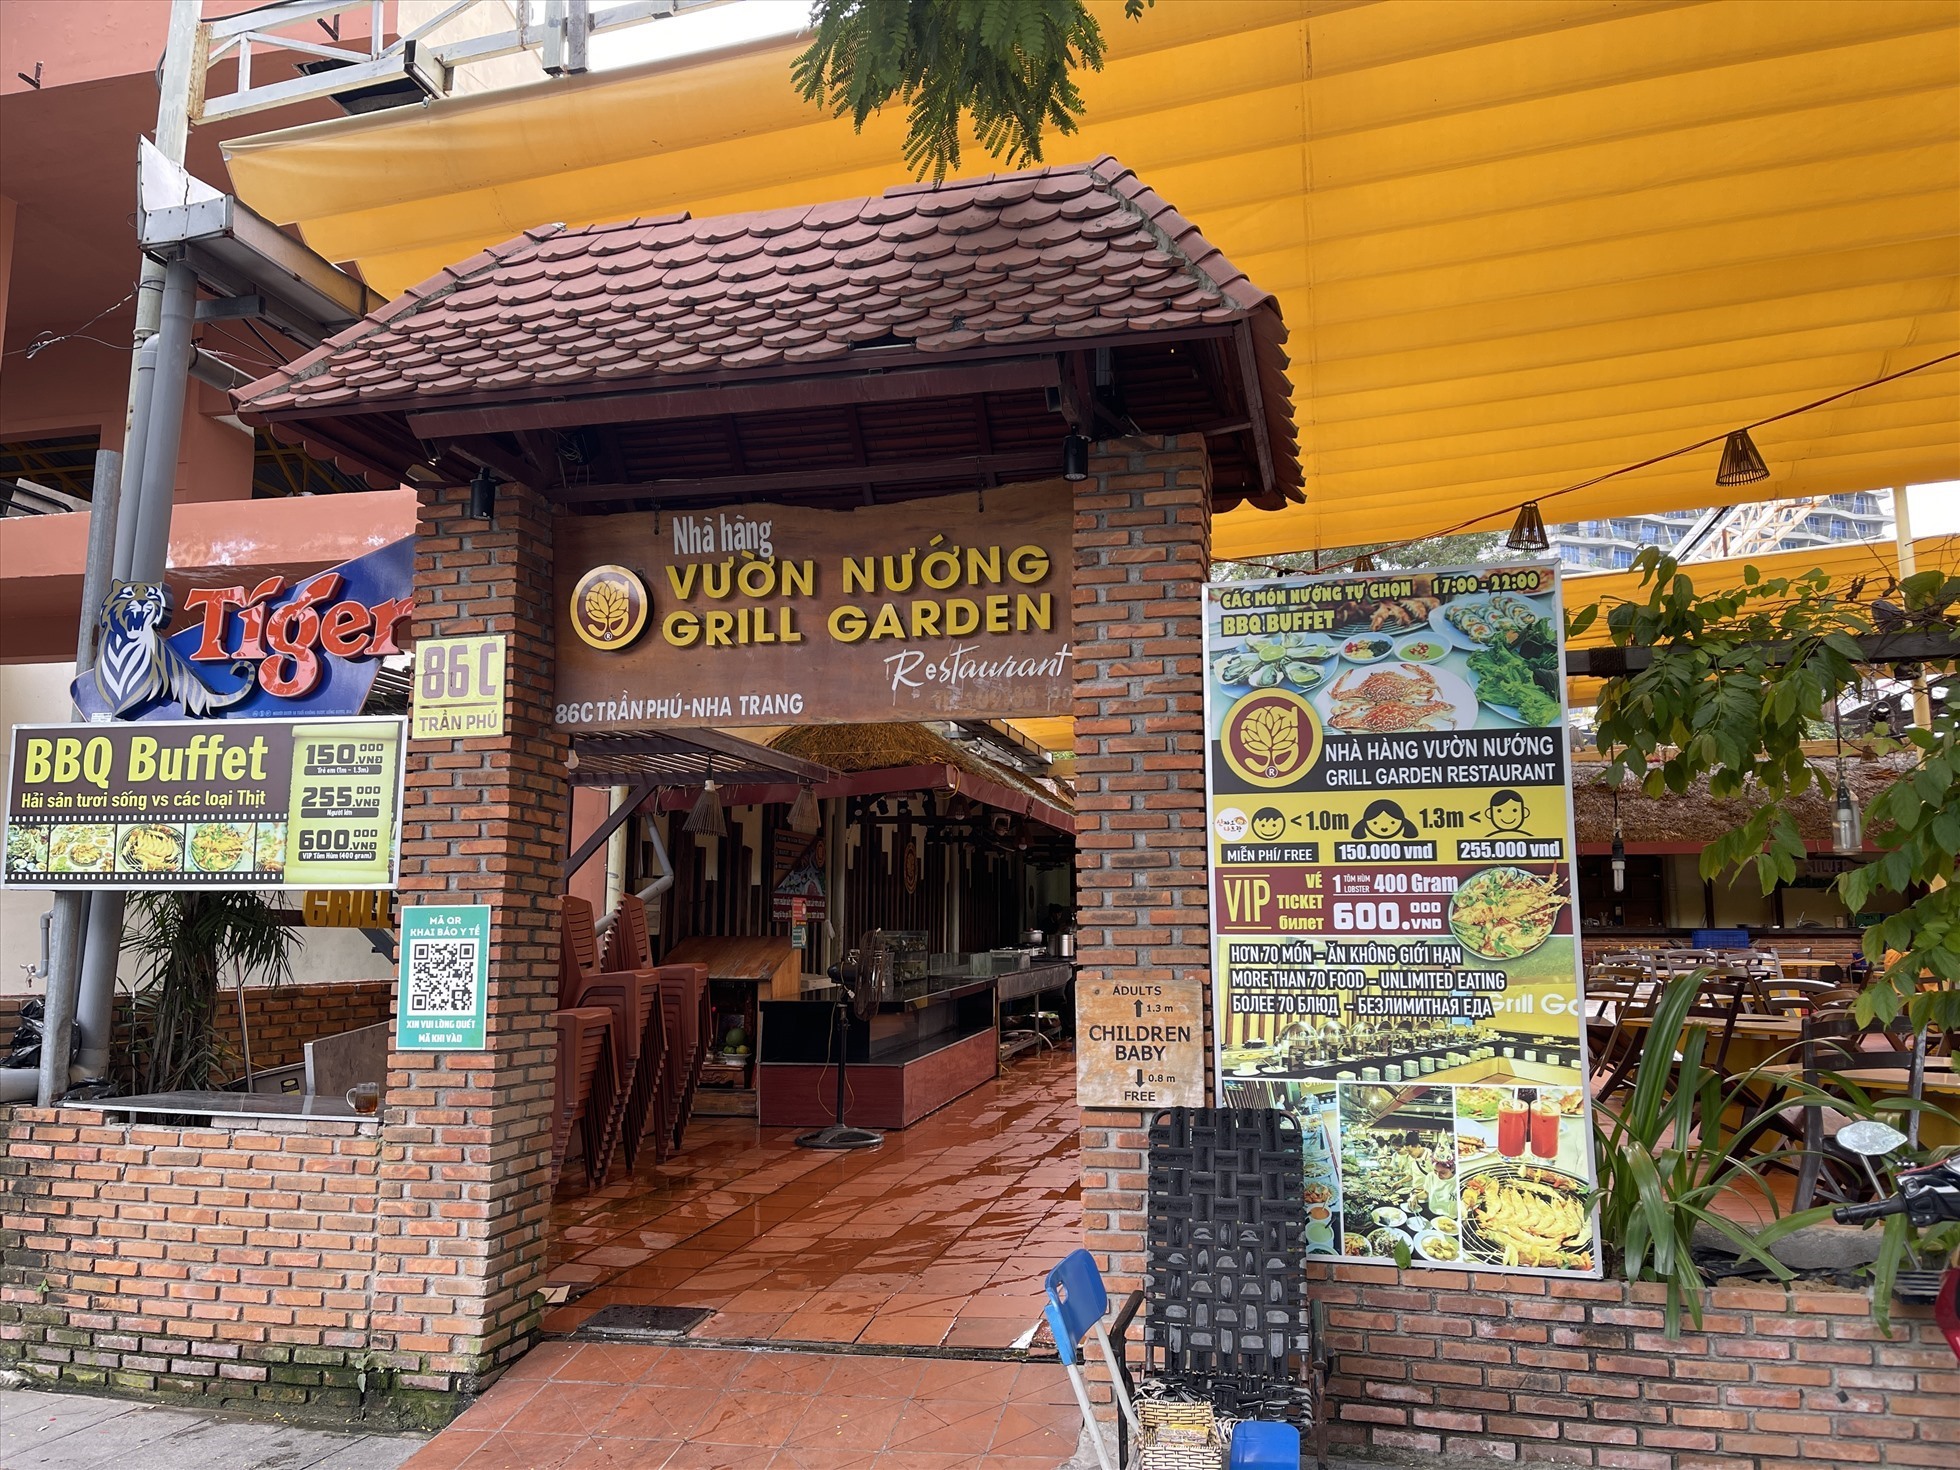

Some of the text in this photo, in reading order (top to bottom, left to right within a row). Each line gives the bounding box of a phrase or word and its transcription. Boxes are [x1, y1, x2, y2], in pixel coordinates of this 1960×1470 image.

[673, 514, 773, 557] Nhà hàng
[665, 533, 1050, 600] VƯỜN NƯỚNG
[1222, 590, 1251, 608] CÁC
[1255, 589, 1286, 606] MÓN
[1290, 584, 1342, 604] NƯỚNG
[1345, 582, 1366, 603] TỰ
[1369, 581, 1411, 601] CHỌN
[662, 592, 1051, 646] GRILL GARDEN
[1223, 610, 1335, 636] BBQ BUFFET
[184, 572, 415, 698] Tiger
[883, 643, 1072, 691] Restaurant
[555, 702, 594, 724] 86C
[596, 690, 643, 721] TRẦN
[740, 693, 804, 716] TRANG
[419, 709, 498, 731] TRẦN PHÚ
[1325, 732, 1554, 762] NHÀ HÀNG VƯỜN NƯỚNG
[24, 734, 269, 789] BBQ Buffet
[1326, 763, 1556, 786] GRILL GARDEN RESTAURANT
[21, 788, 266, 812] Hải sản tươi sống vs các loại Thịt
[1306, 810, 1349, 831] 1.0m
[1419, 807, 1464, 829] 1.3m
[1227, 845, 1255, 862] MIỄN
[1284, 849, 1313, 861] FREE
[1338, 842, 1433, 861] 150.000 vnd
[1460, 840, 1560, 859] 255.000 vnd
[1305, 871, 1323, 889] VÉ
[1332, 873, 1459, 893] 1 TÔM HÙM 400 Gram
[1343, 885, 1371, 893] LOBSTER
[303, 890, 392, 928] GRILL
[1223, 879, 1271, 923] VIP
[1276, 894, 1324, 910] TICKET
[429, 914, 462, 925] MÃ QR
[1279, 915, 1325, 930] билет
[410, 923, 481, 937] KHAI BÁO Y TẾ
[1231, 945, 1259, 963] HƠN
[1262, 945, 1279, 963] 70
[1282, 942, 1312, 963] MÓN
[1327, 942, 1346, 963] ĂN
[1349, 943, 1396, 964] KHÔNG
[1400, 943, 1429, 964] GIỚI
[1433, 946, 1461, 967] HẠN
[1231, 970, 1269, 987] MORE
[1271, 970, 1306, 988] THAN
[1309, 971, 1326, 988] 70
[1329, 971, 1365, 989] FOOD
[1381, 972, 1453, 989] UNLIMITED
[1458, 972, 1505, 990] EATING
[1112, 985, 1162, 996] ADULTS
[1146, 1004, 1174, 1013] 1.3 m
[1232, 995, 1275, 1012] БОЛЕЕ
[1277, 996, 1294, 1013] 70
[1297, 996, 1339, 1016] БЛЮД
[1358, 997, 1459, 1015] БЕЗЛИМИТНАЯ
[1463, 998, 1493, 1018] ЕДА
[406, 1018, 476, 1029] XIN VUI LÒNG QUÉT
[418, 1032, 463, 1043] MÃ KHI VÀO
[1088, 1025, 1191, 1043] CHILDREN
[1115, 1045, 1167, 1061] BABY
[1148, 1074, 1164, 1083] 0.8
[1124, 1091, 1156, 1101] FREE
